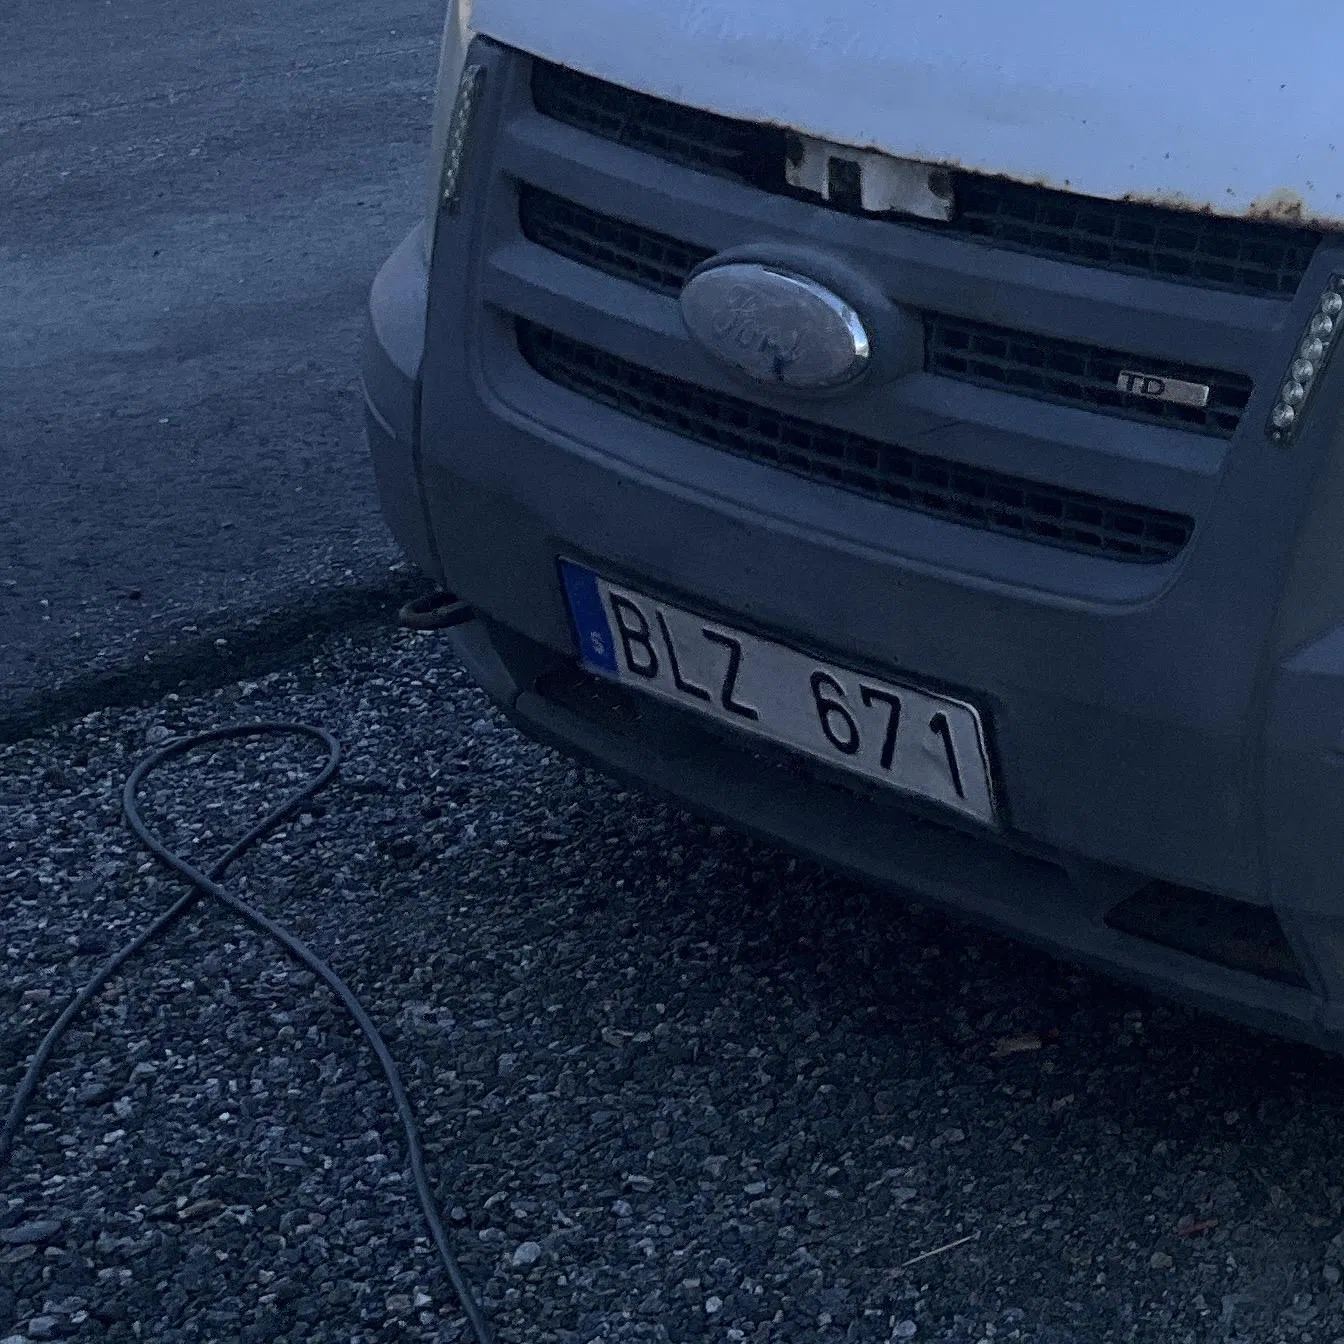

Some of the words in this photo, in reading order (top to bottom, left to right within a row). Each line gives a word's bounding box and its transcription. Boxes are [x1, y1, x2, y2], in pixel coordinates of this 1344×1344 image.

[1120, 372, 1165, 395] TD
[610, 592, 759, 720] BLZ
[810, 671, 966, 798] 671
